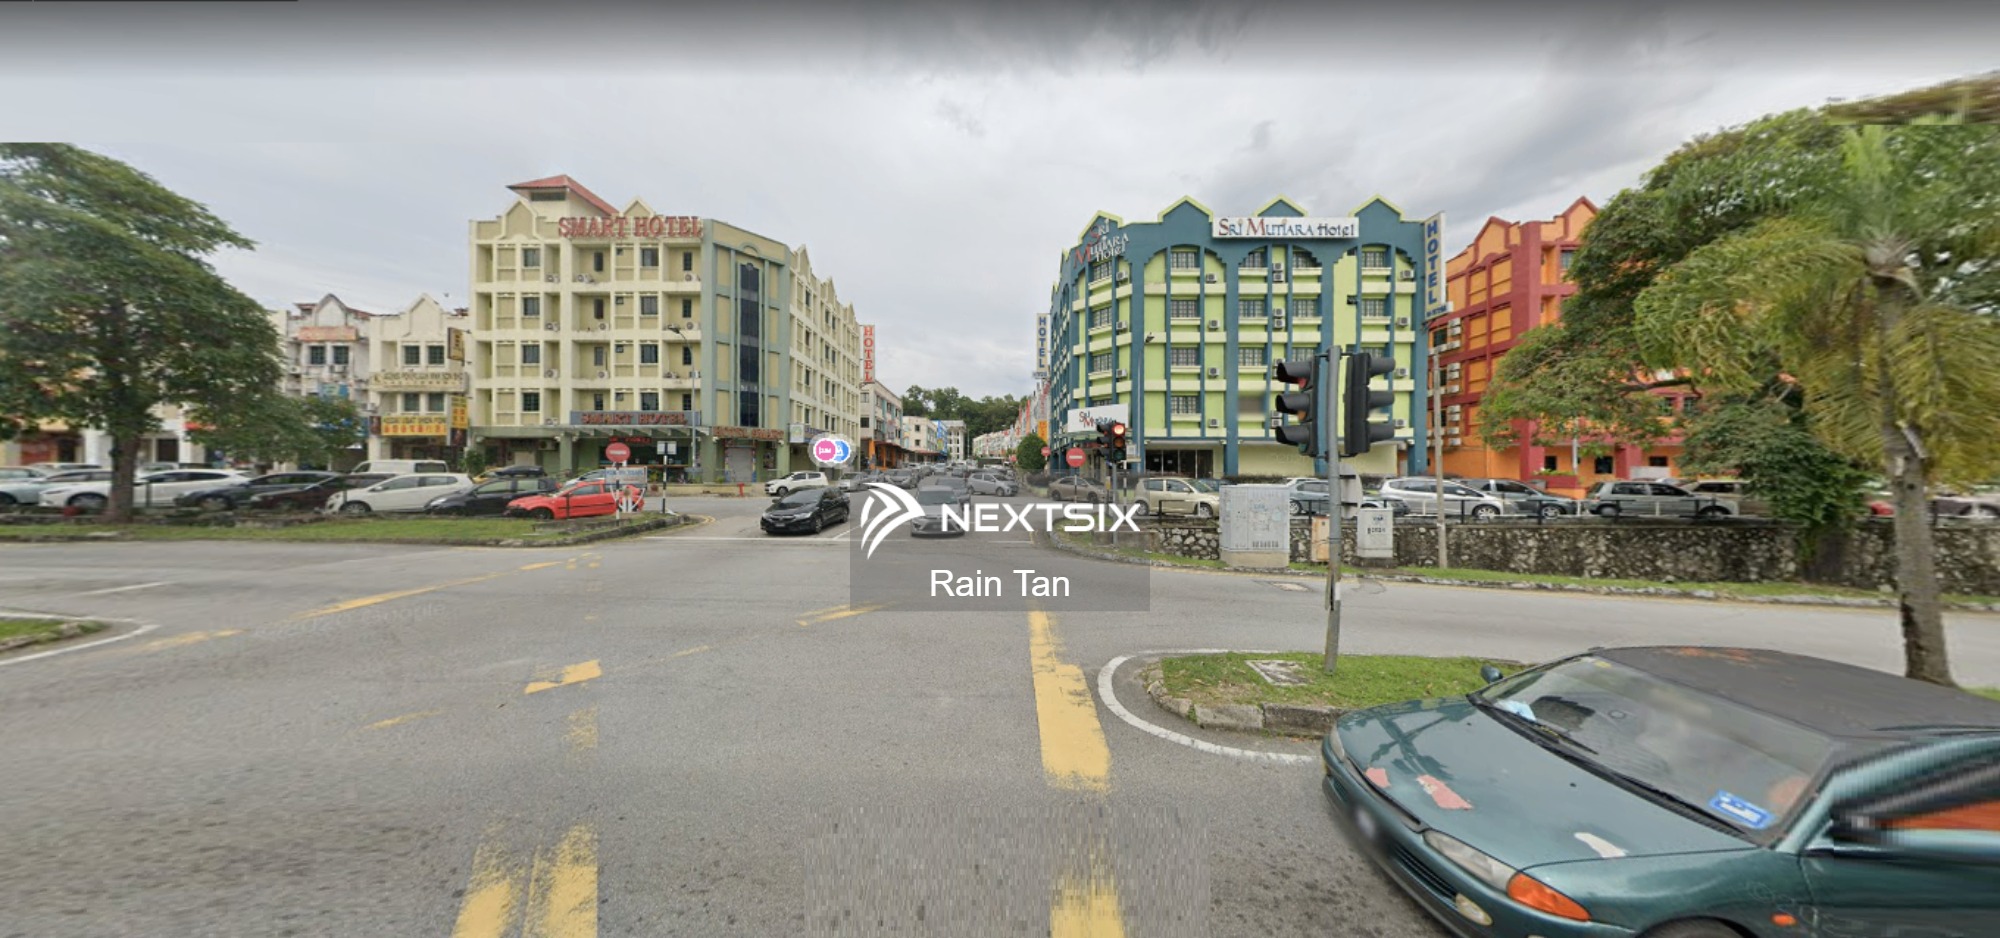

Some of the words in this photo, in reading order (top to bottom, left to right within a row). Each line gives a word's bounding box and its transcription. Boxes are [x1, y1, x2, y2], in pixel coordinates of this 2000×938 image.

[559, 216, 628, 238] SMART
[633, 215, 703, 238] HOTEL
[1427, 220, 1438, 305] HOTEL
[863, 326, 873, 382] HOTEL
[1038, 317, 1047, 368] HOTEL
[581, 413, 632, 424] SMART
[638, 413, 687, 425] HOTEL
